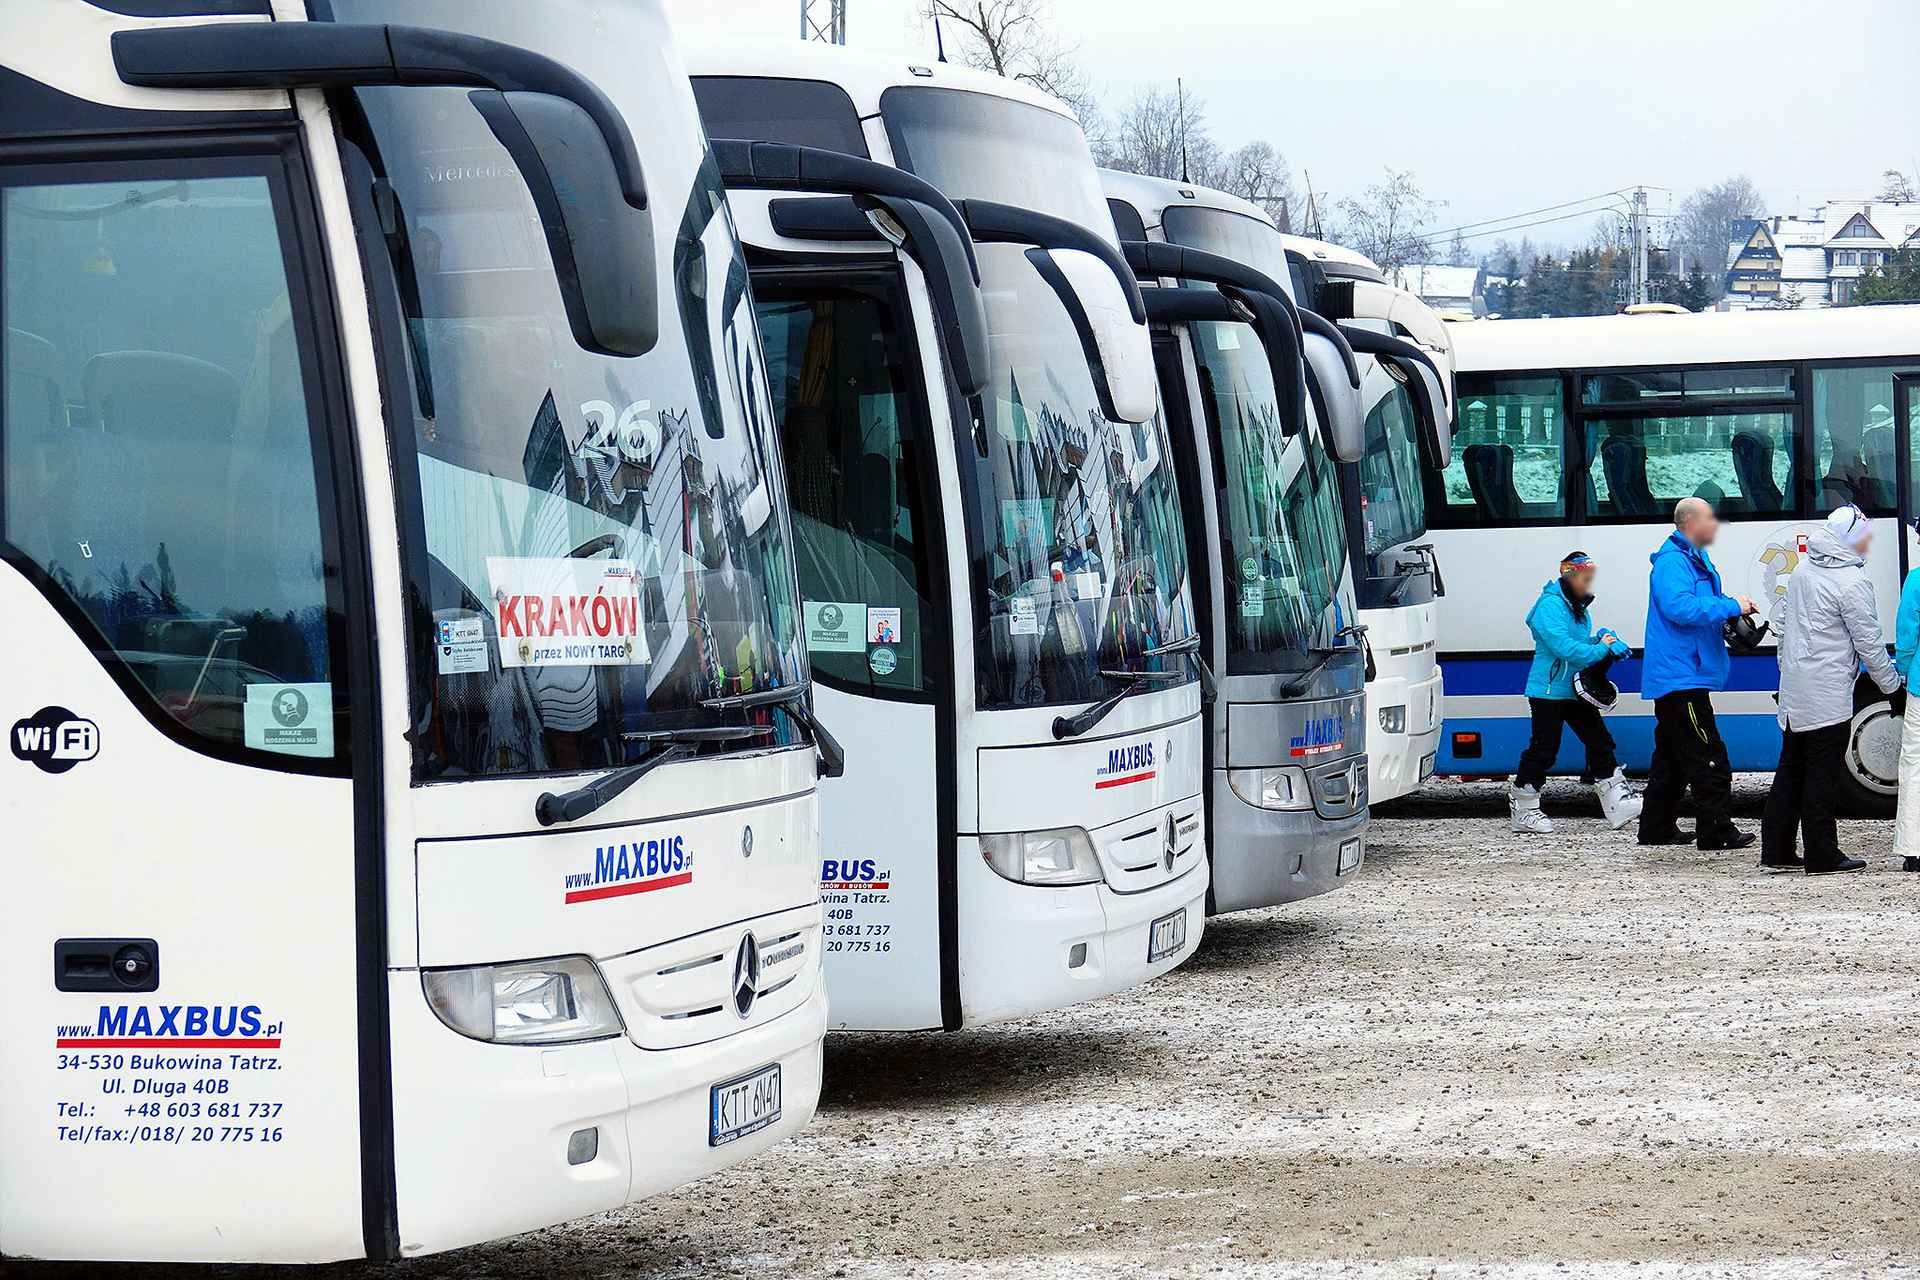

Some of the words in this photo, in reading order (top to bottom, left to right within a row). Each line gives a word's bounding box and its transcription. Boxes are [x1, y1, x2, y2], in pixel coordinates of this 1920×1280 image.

[580, 399, 659, 459] 26
[498, 586, 637, 638] KRAKÓW
[534, 649, 562, 662] przez
[565, 645, 595, 658] NOWY
[597, 645, 625, 658] TARG
[565, 835, 693, 889] www.MAXBUS.pl
[853, 893, 890, 904] Tatrz.
[828, 909, 853, 920] 40B
[837, 925, 861, 936] 681
[866, 925, 890, 936] 737
[826, 941, 842, 952] 20
[847, 941, 870, 952] 775
[875, 941, 891, 952] 16
[57, 1005, 283, 1037] www.MAXBUS.pl
[57, 1054, 124, 1070] 34-530
[130, 1054, 222, 1070] Bukowina
[230, 1055, 282, 1070] Tatrz.
[102, 1079, 126, 1094] Ul.
[133, 1079, 186, 1098] Dluga
[193, 1079, 229, 1094] 40B
[57, 1102, 96, 1117] Tel.:
[124, 1103, 160, 1117] +48
[167, 1103, 201, 1117] 603
[207, 1103, 240, 1117] 681
[248, 1103, 283, 1117] 737
[721, 1085, 749, 1130] KTT
[753, 1073, 778, 1118] 6N47
[191, 1127, 214, 1142] 20
[220, 1127, 254, 1142] 775
[261, 1127, 283, 1142] 16
